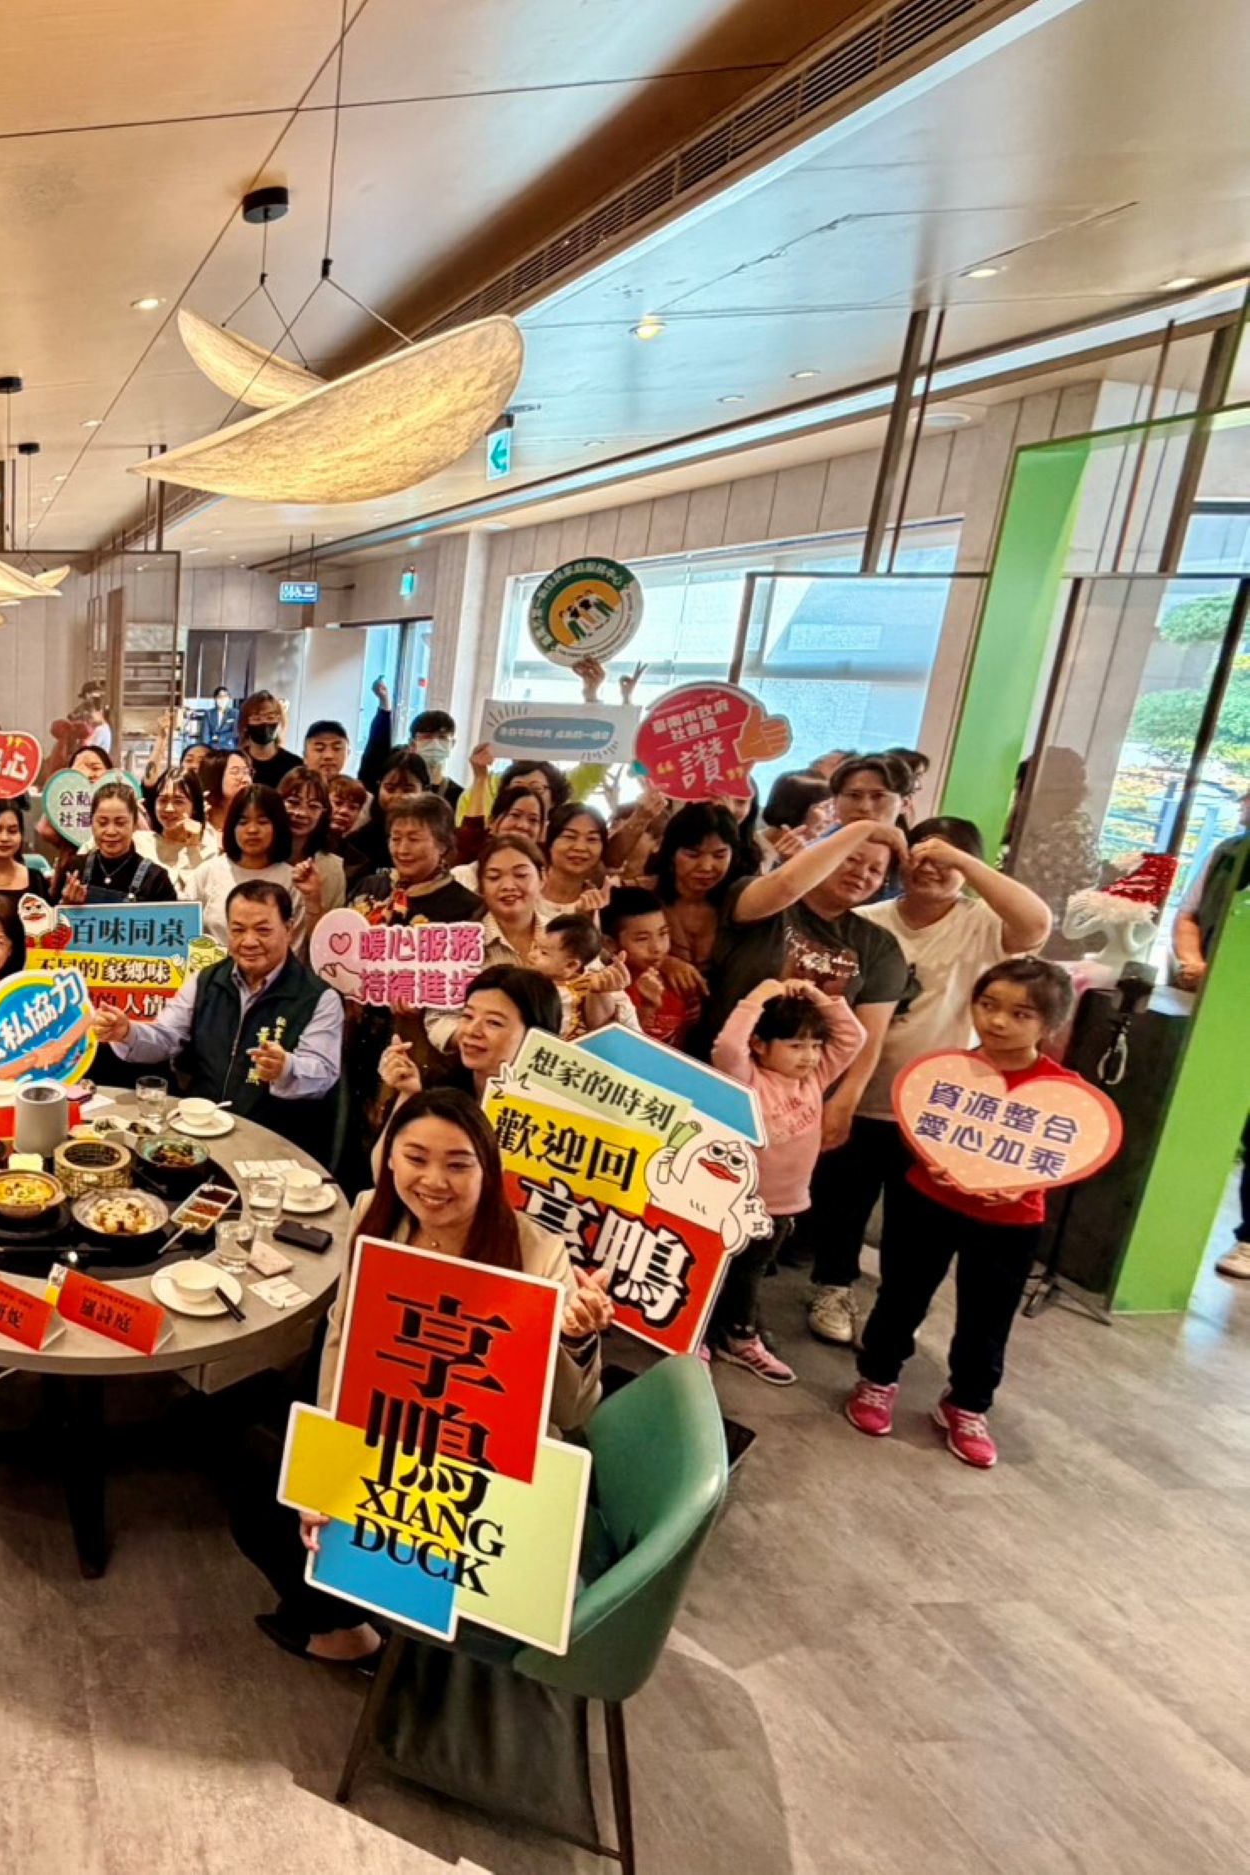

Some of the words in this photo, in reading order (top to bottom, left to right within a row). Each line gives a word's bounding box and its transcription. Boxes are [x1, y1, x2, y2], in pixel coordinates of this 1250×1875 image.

[652, 699, 729, 735] 臺南市政府
[670, 717, 717, 742] 社會局
[679, 736, 725, 790] 讚
[71, 916, 185, 947] 百味同桌
[360, 926, 482, 963] 暖心服務
[361, 968, 478, 1006] 持續進步
[527, 1047, 676, 1130] 想家的時刻
[928, 1080, 1079, 1145] 資源整合
[496, 1106, 639, 1192] 歡迎回
[914, 1110, 1067, 1178] 愛心加乘
[365, 1293, 513, 1513] 享鴨
[355, 1476, 506, 1558] XIANG
[350, 1514, 490, 1597] DUCK
